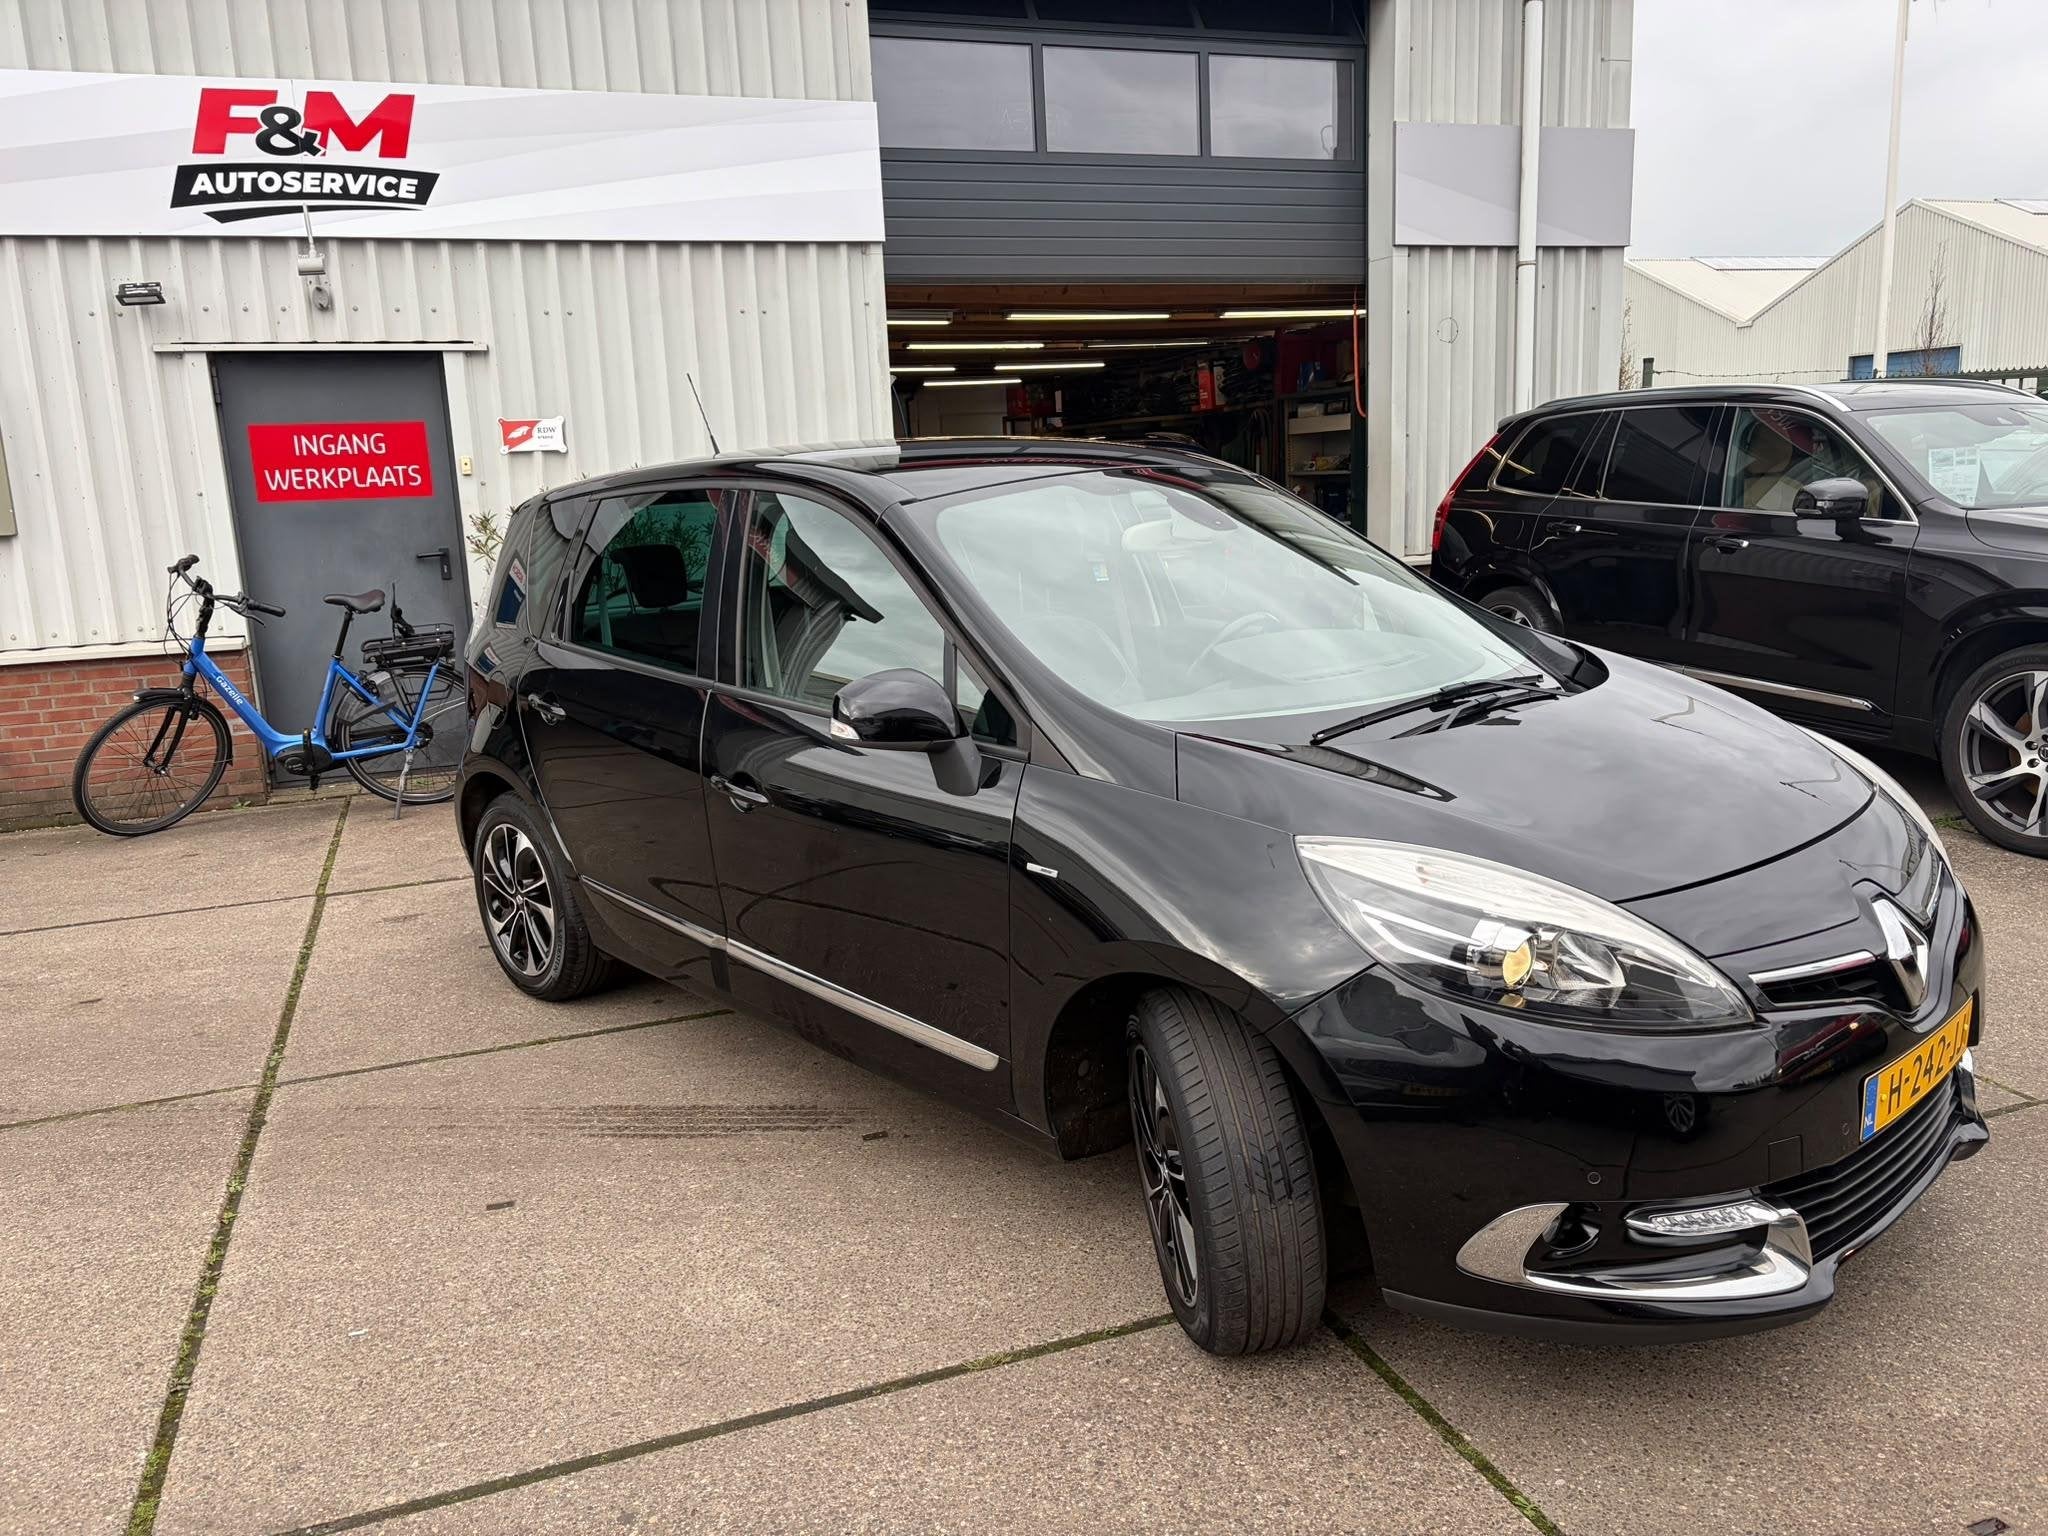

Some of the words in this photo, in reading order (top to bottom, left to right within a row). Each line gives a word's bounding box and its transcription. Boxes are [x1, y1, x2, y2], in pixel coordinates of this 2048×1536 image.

[192, 88, 415, 159] F&M
[190, 171, 419, 200] AUTOSERVICE
[293, 433, 386, 456] INGANG
[264, 465, 423, 491] WERKPLAATS
